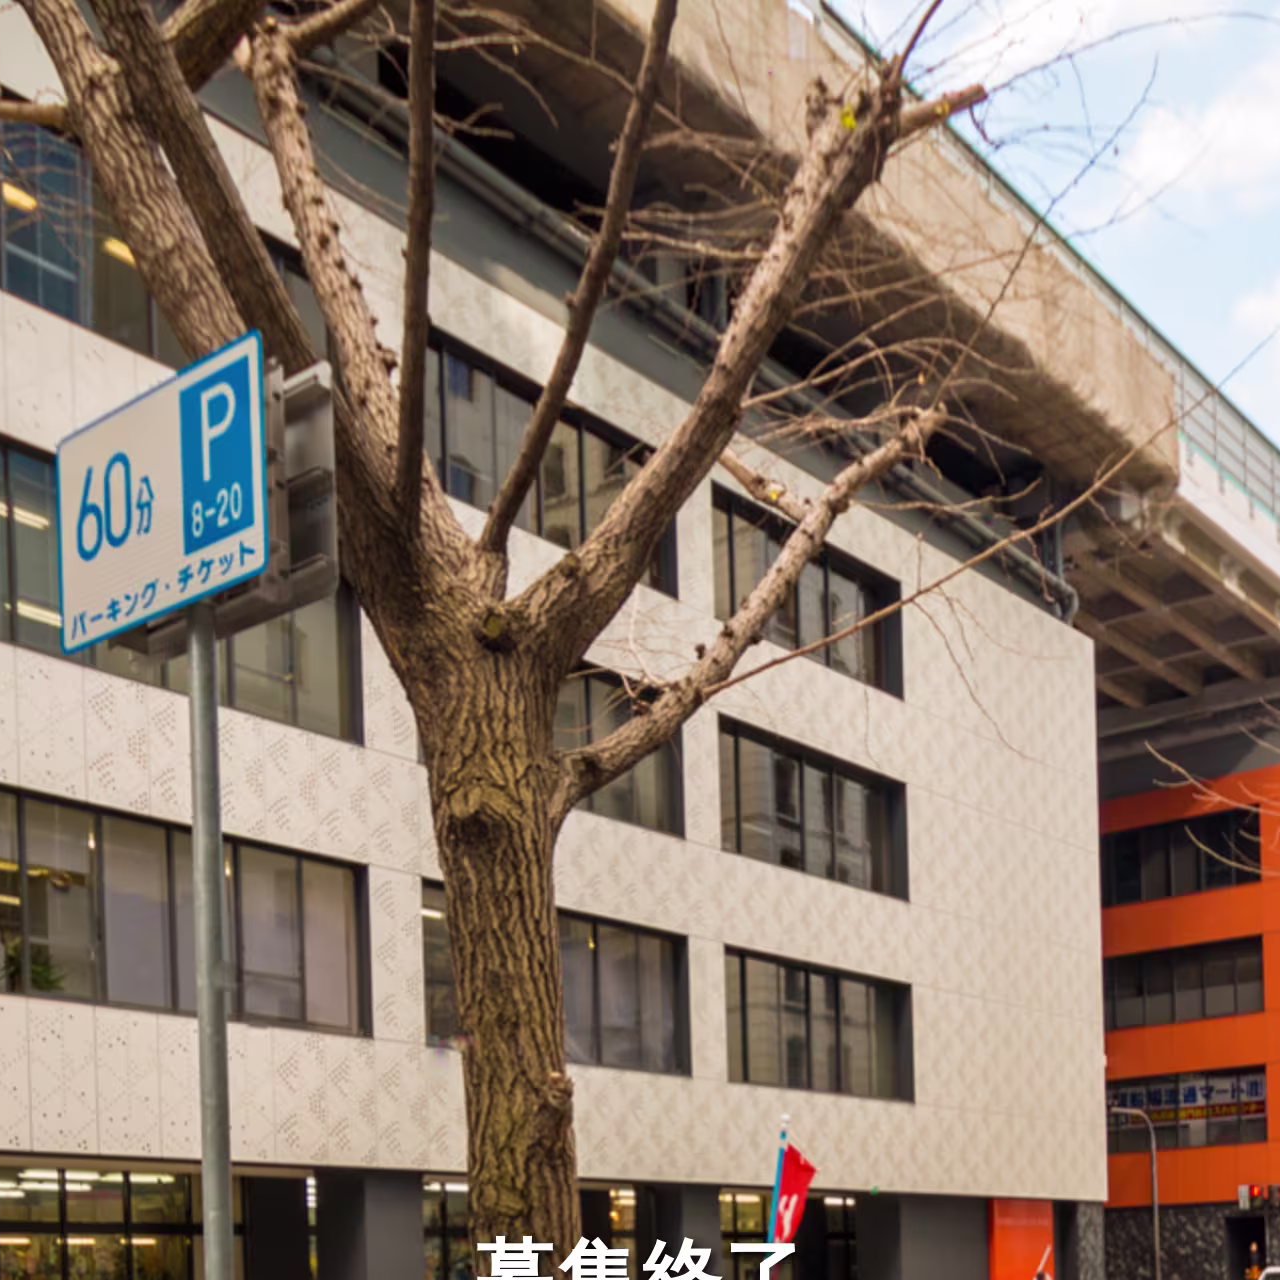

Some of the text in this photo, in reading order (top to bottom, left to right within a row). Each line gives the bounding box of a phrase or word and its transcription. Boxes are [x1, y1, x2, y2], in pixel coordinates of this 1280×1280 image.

[200, 381, 237, 483] P
[76, 452, 155, 562] 60分
[191, 482, 243, 539] 8-20
